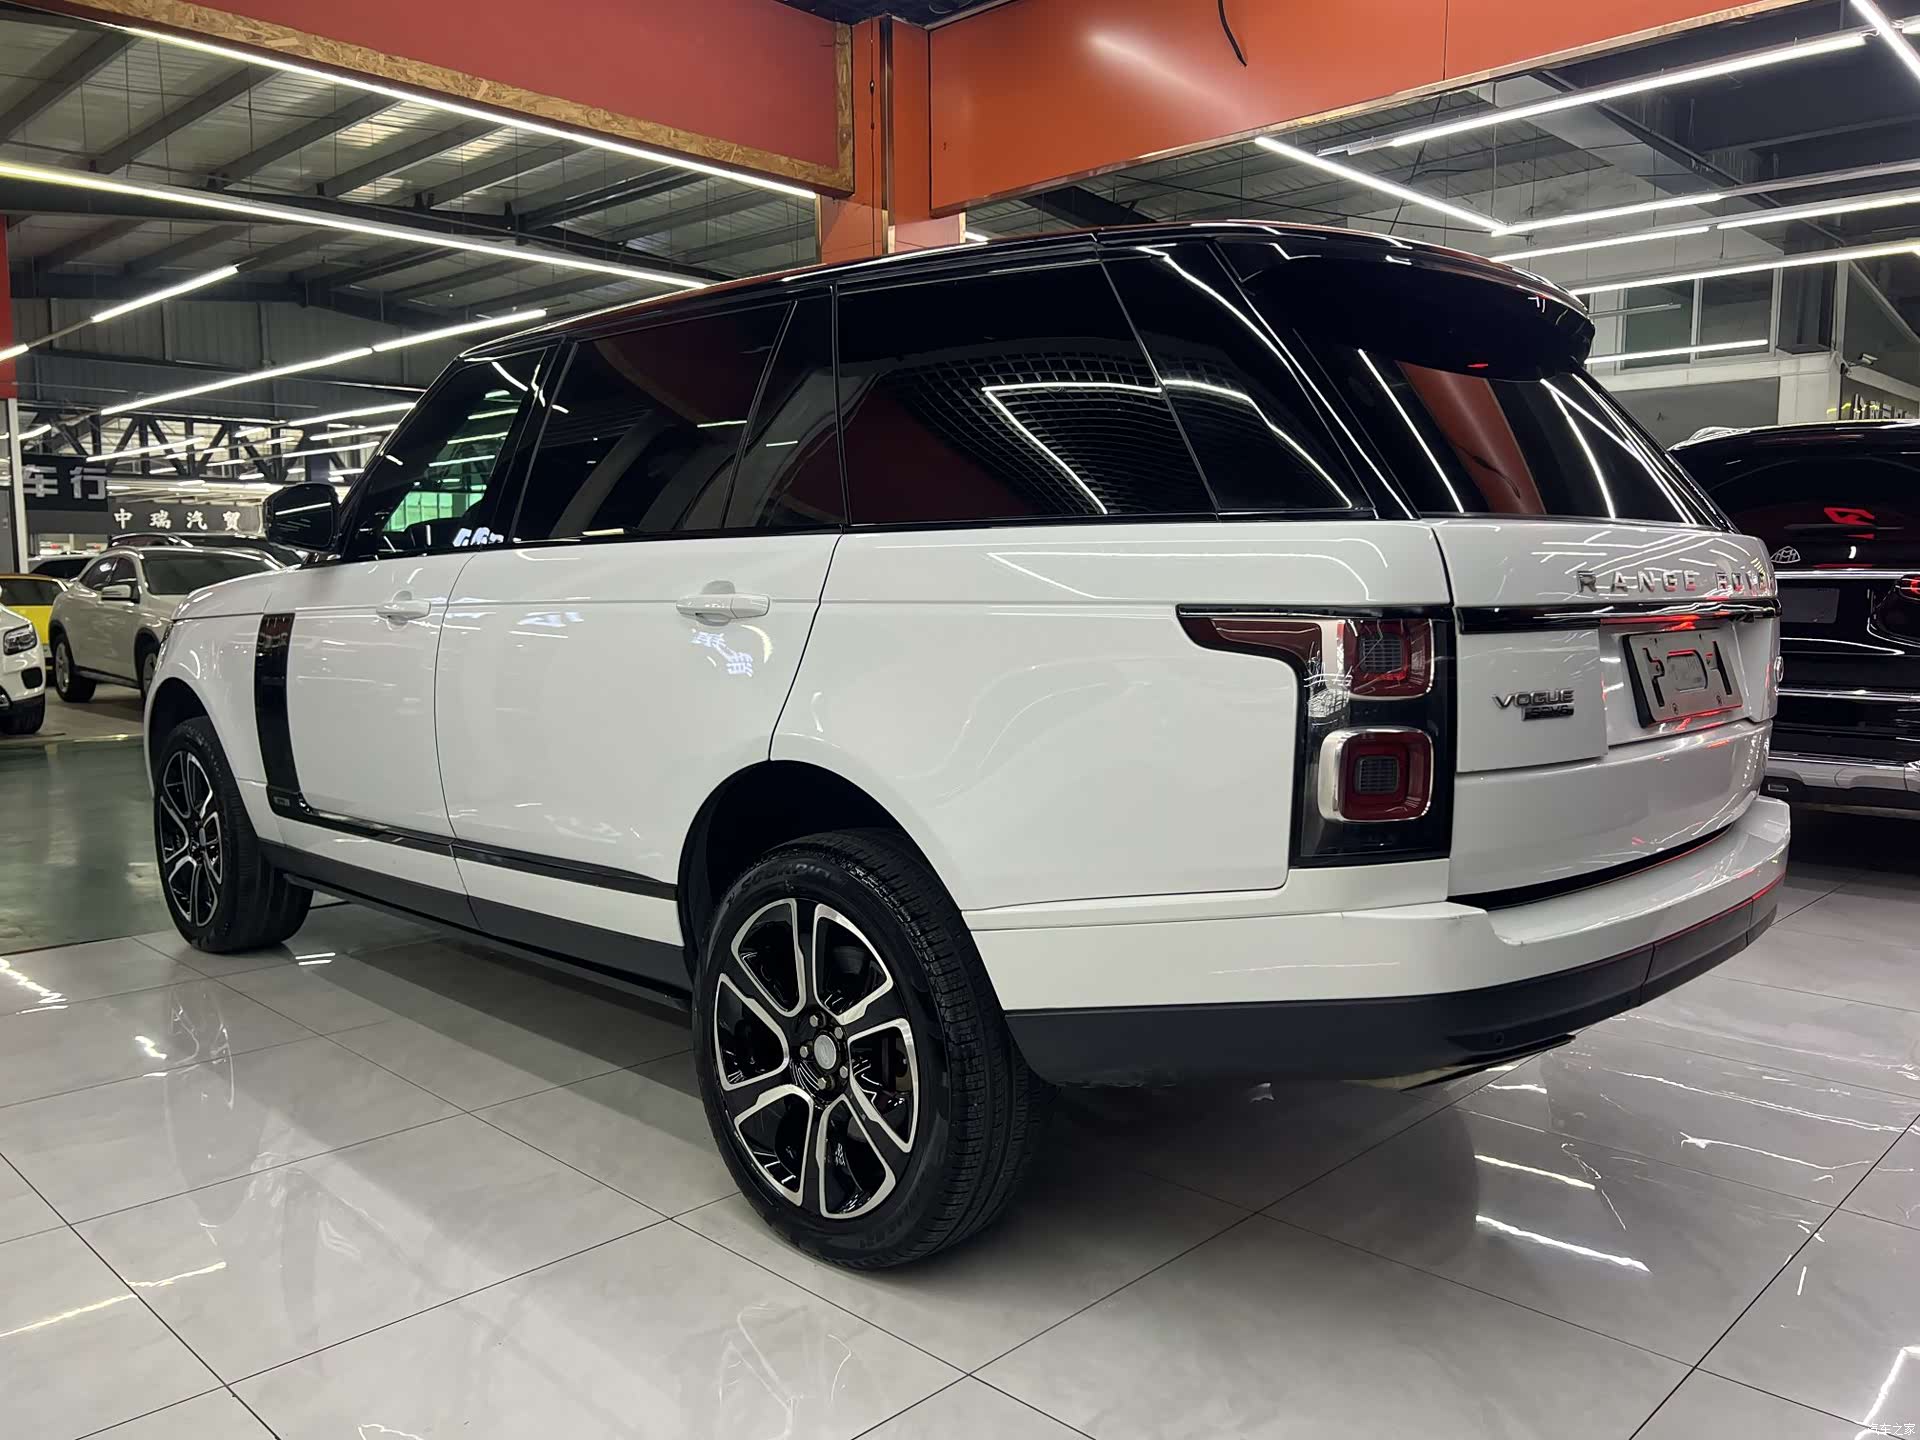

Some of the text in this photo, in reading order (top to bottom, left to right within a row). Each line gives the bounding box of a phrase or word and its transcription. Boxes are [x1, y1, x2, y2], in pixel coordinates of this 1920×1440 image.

[22, 464, 106, 500] 车行
[1577, 570, 1697, 594] RANGE
[1491, 689, 1575, 710] VOGUE
